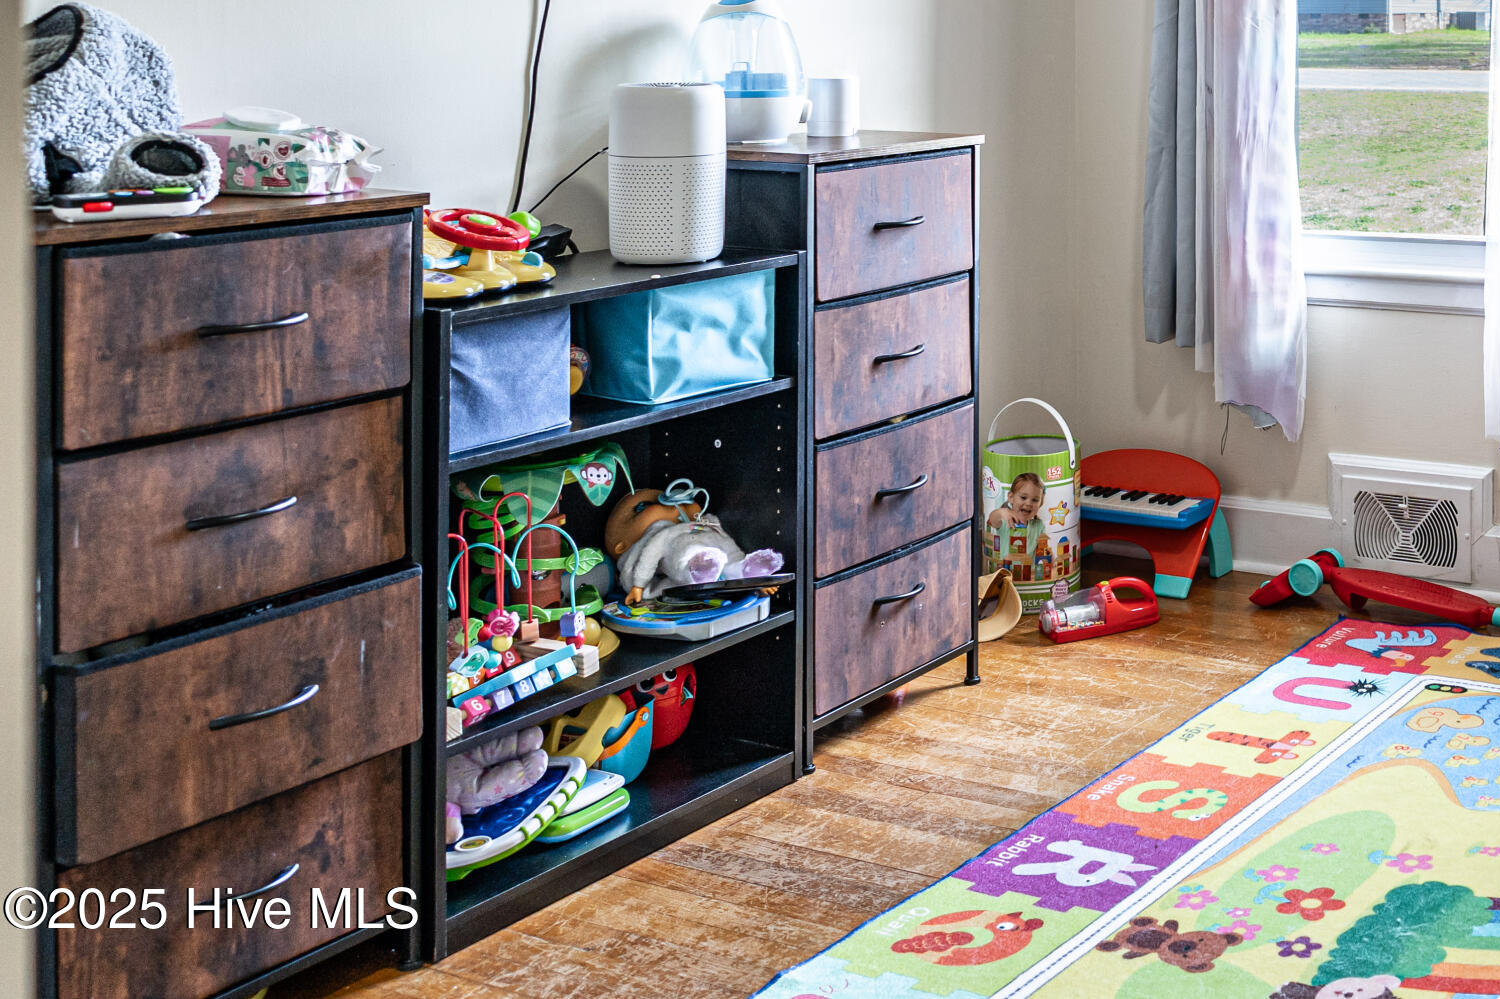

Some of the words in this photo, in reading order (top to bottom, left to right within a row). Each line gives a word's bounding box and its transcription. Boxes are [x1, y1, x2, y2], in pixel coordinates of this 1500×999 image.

[1315, 627, 1356, 648] Vulture
[470, 699, 483, 711] 6
[496, 687, 506, 704] 7
[520, 680, 529, 693] 8
[1178, 722, 1216, 742] Tiger
[1086, 773, 1136, 801] Snake
[985, 833, 1046, 868] Rabbit
[876, 906, 932, 938] Quail
